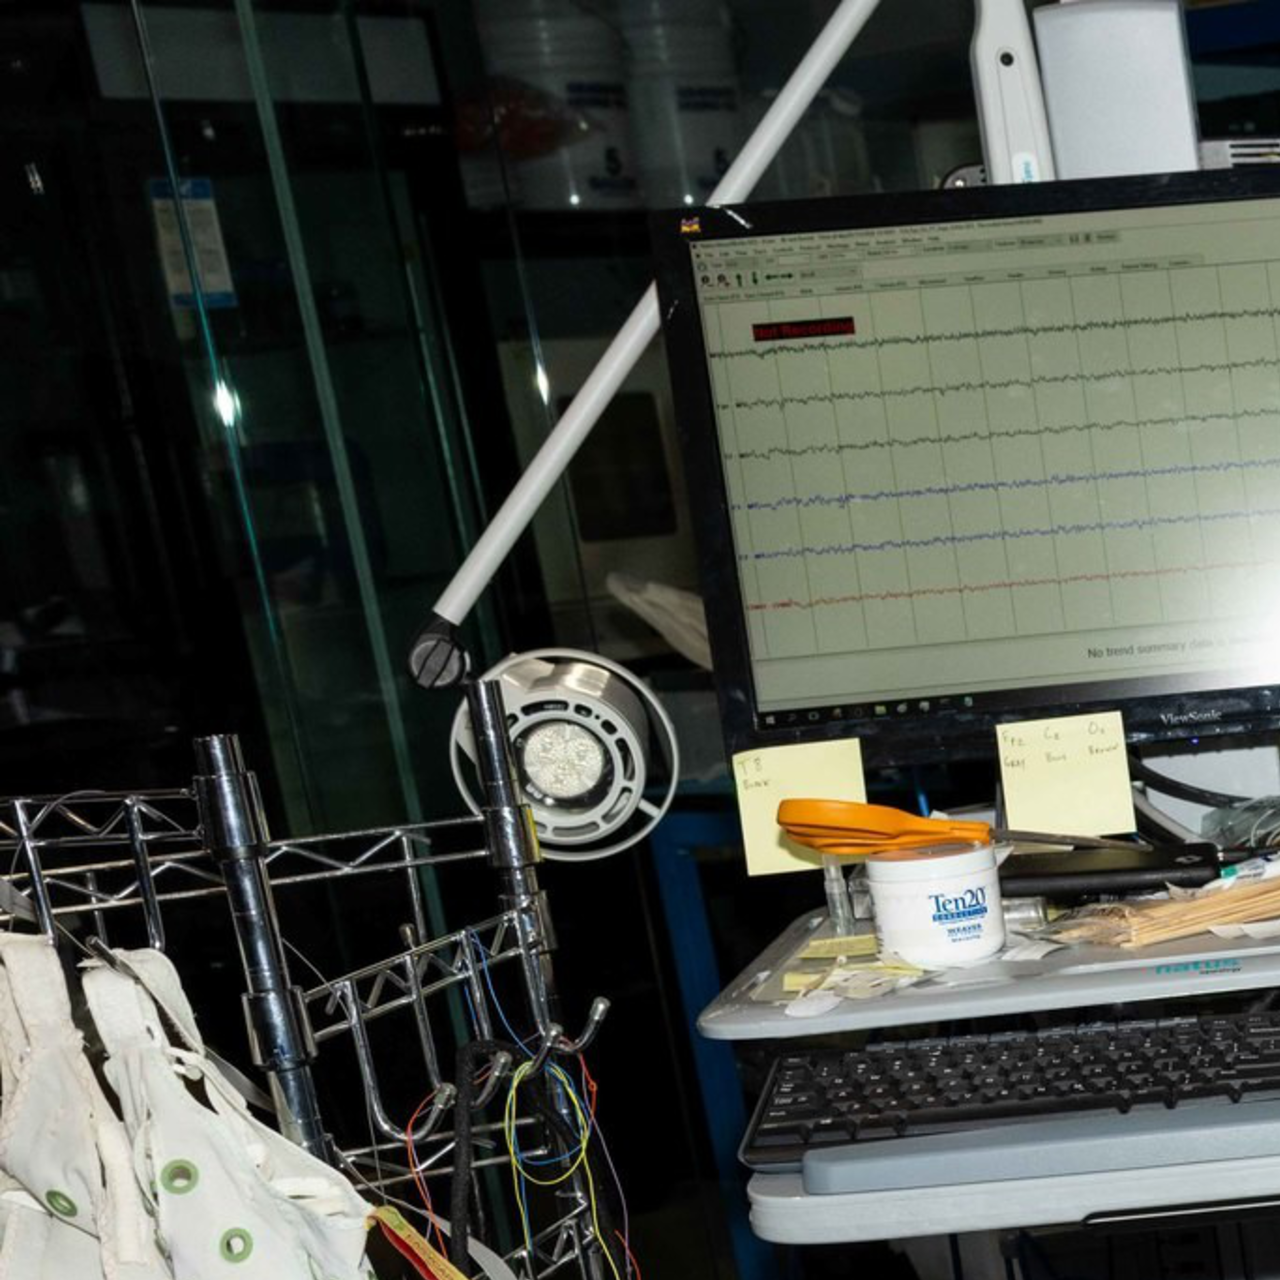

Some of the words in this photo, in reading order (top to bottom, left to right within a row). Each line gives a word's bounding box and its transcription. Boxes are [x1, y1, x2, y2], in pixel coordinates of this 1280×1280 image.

[1088, 647, 1104, 659] No
[1106, 644, 1135, 657] trend
[1159, 709, 1223, 725] ViewSonic
[928, 886, 987, 914] Ten20
